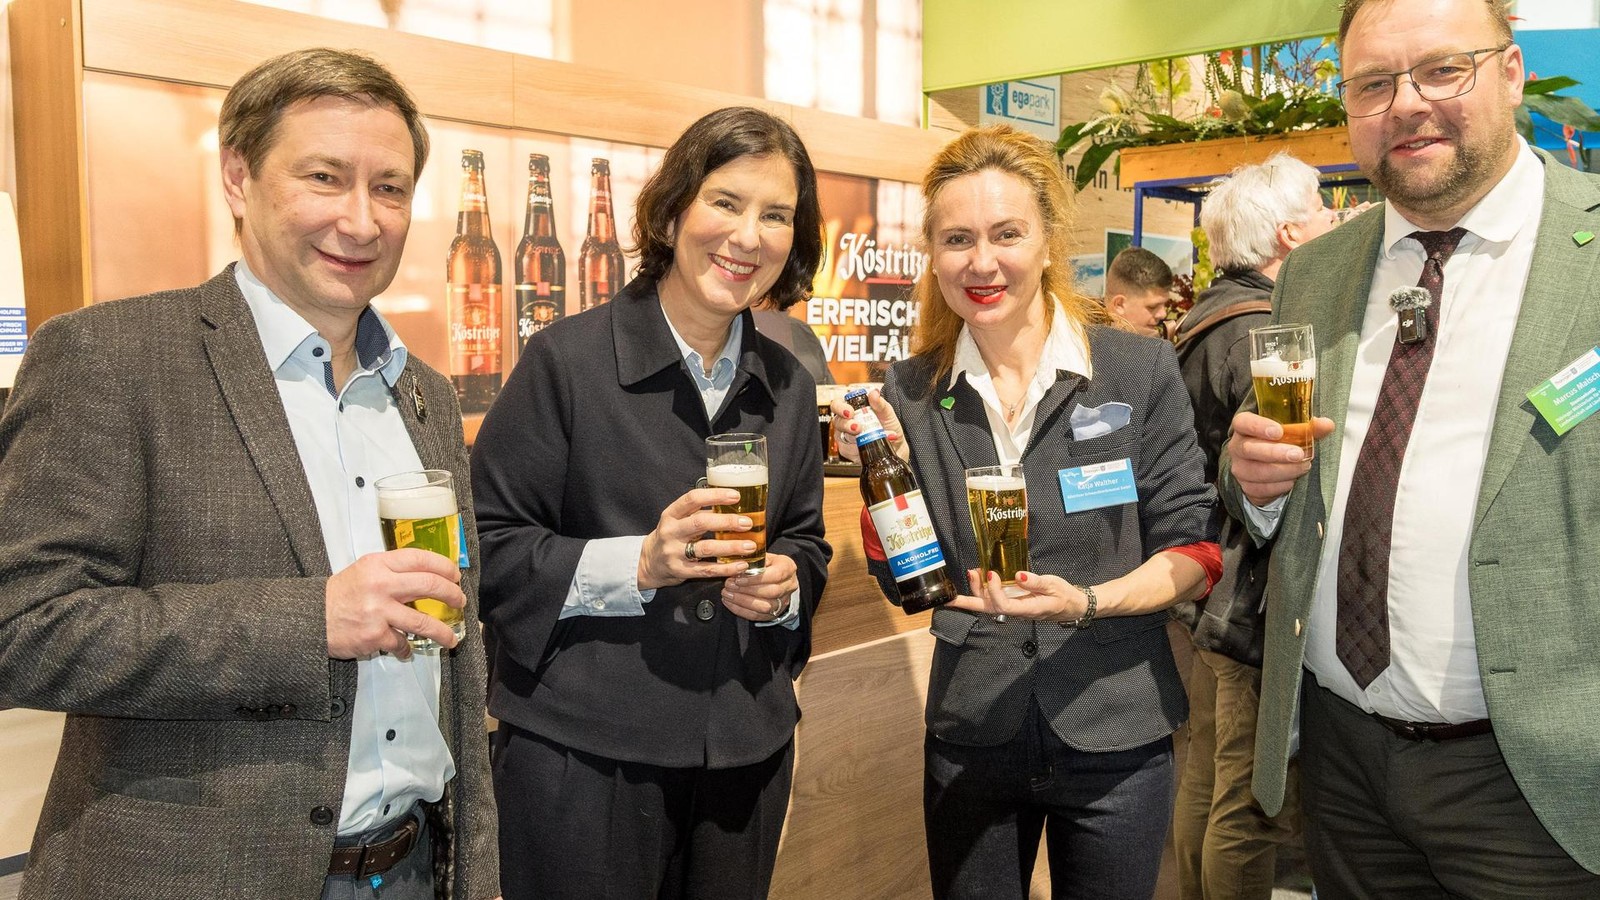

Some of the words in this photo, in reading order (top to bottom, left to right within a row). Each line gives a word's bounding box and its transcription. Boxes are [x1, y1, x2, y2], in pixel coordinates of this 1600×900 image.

[1012, 90, 1050, 110] egapark
[1553, 387, 1578, 406] Marcus
[1094, 478, 1118, 487] Walther
